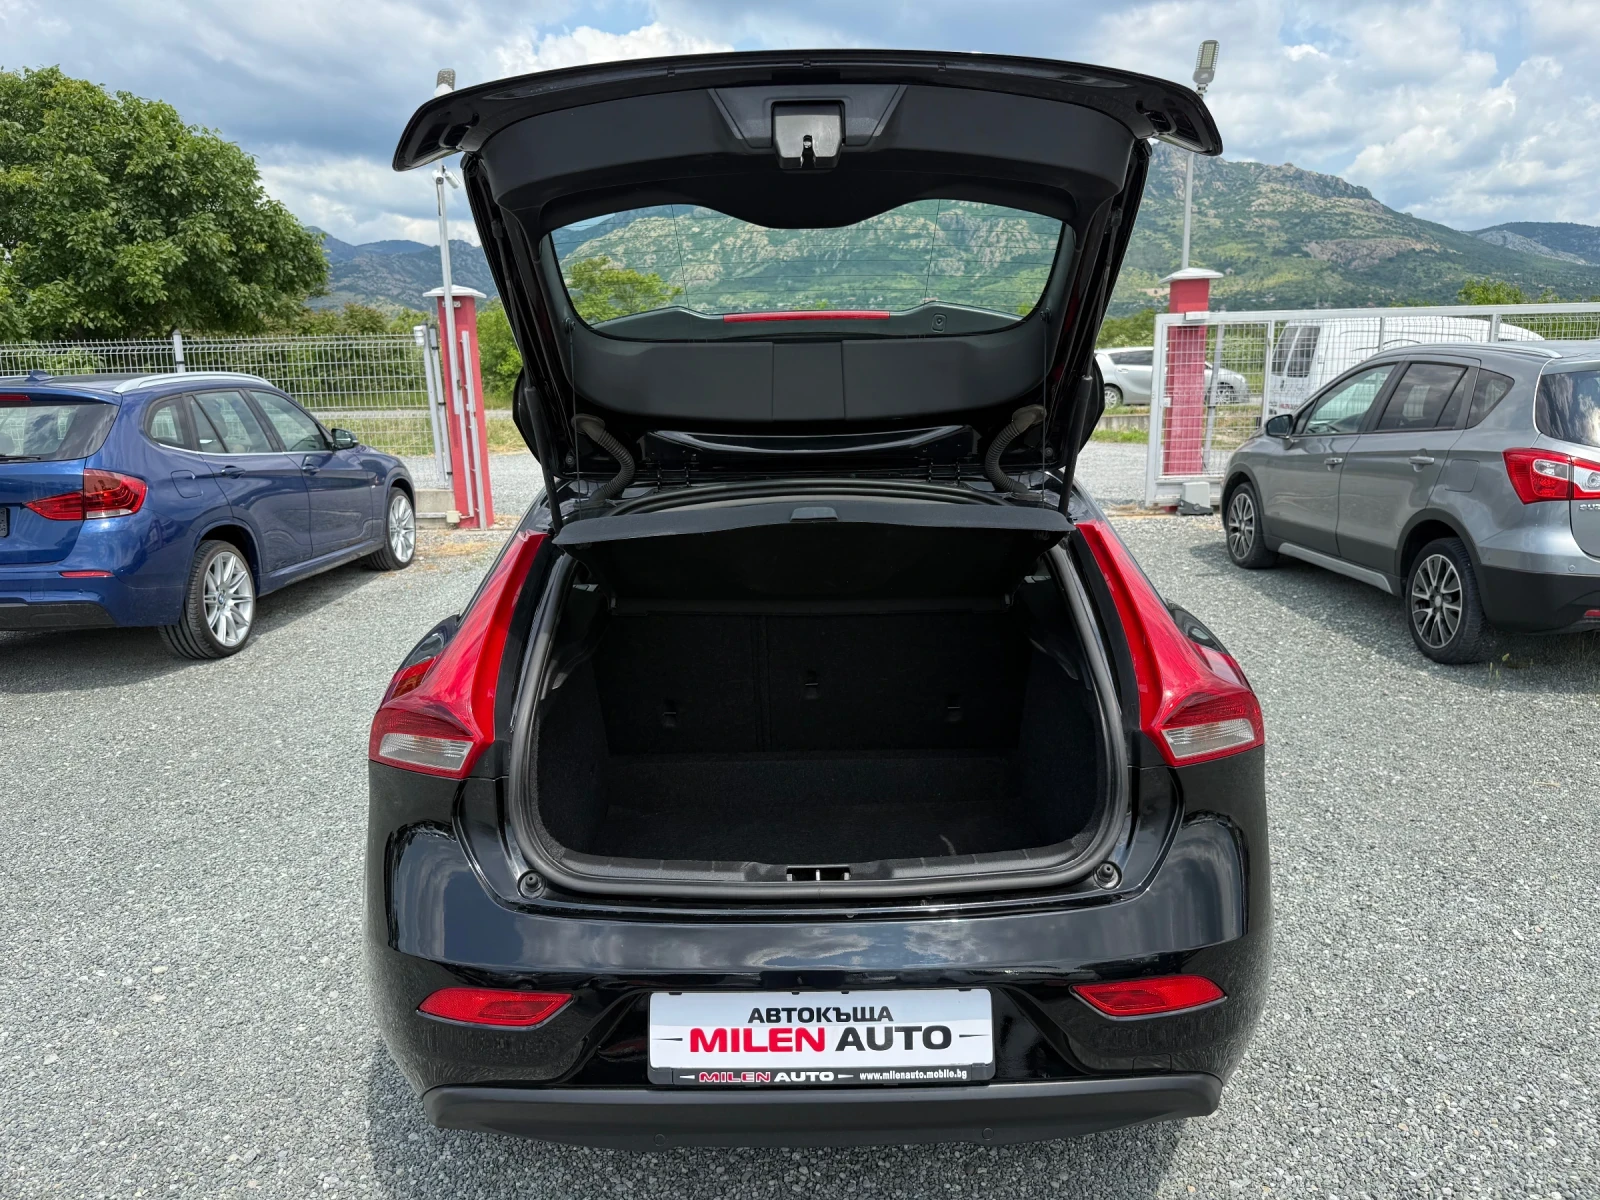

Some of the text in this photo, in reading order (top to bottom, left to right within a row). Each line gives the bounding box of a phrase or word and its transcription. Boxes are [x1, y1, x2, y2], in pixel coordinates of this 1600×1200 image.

[690, 1025, 952, 1053] MILEN AUTO
[698, 1071, 771, 1083] MILEN
[774, 1071, 835, 1083] AUTO
